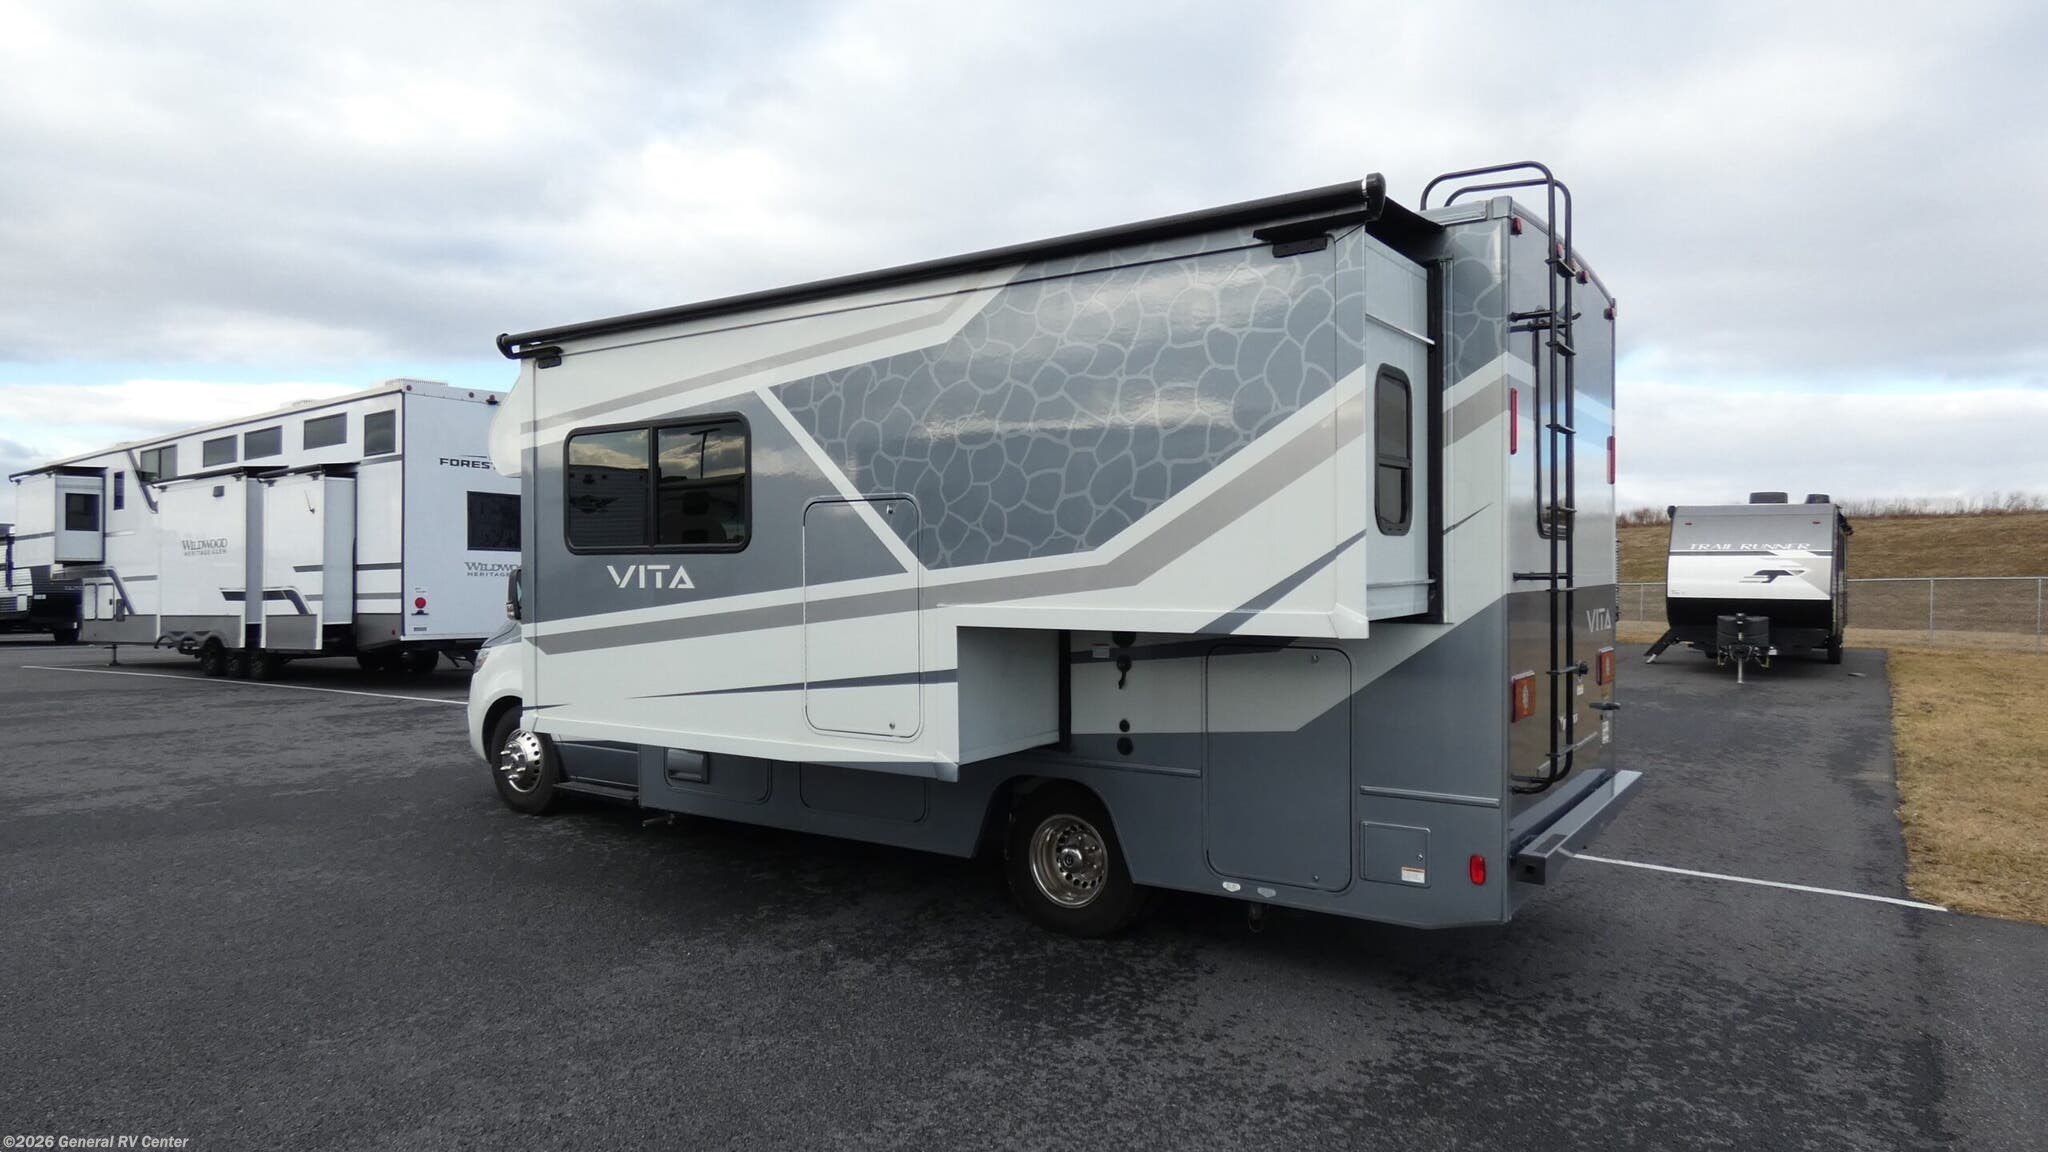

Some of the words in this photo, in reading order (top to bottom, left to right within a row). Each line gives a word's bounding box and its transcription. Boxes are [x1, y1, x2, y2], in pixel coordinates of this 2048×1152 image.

[1690, 543, 1732, 551] TRAIL
[1739, 543, 1811, 551] RUNNER
[606, 564, 695, 589] VITA
[1586, 608, 1612, 633] VITA
